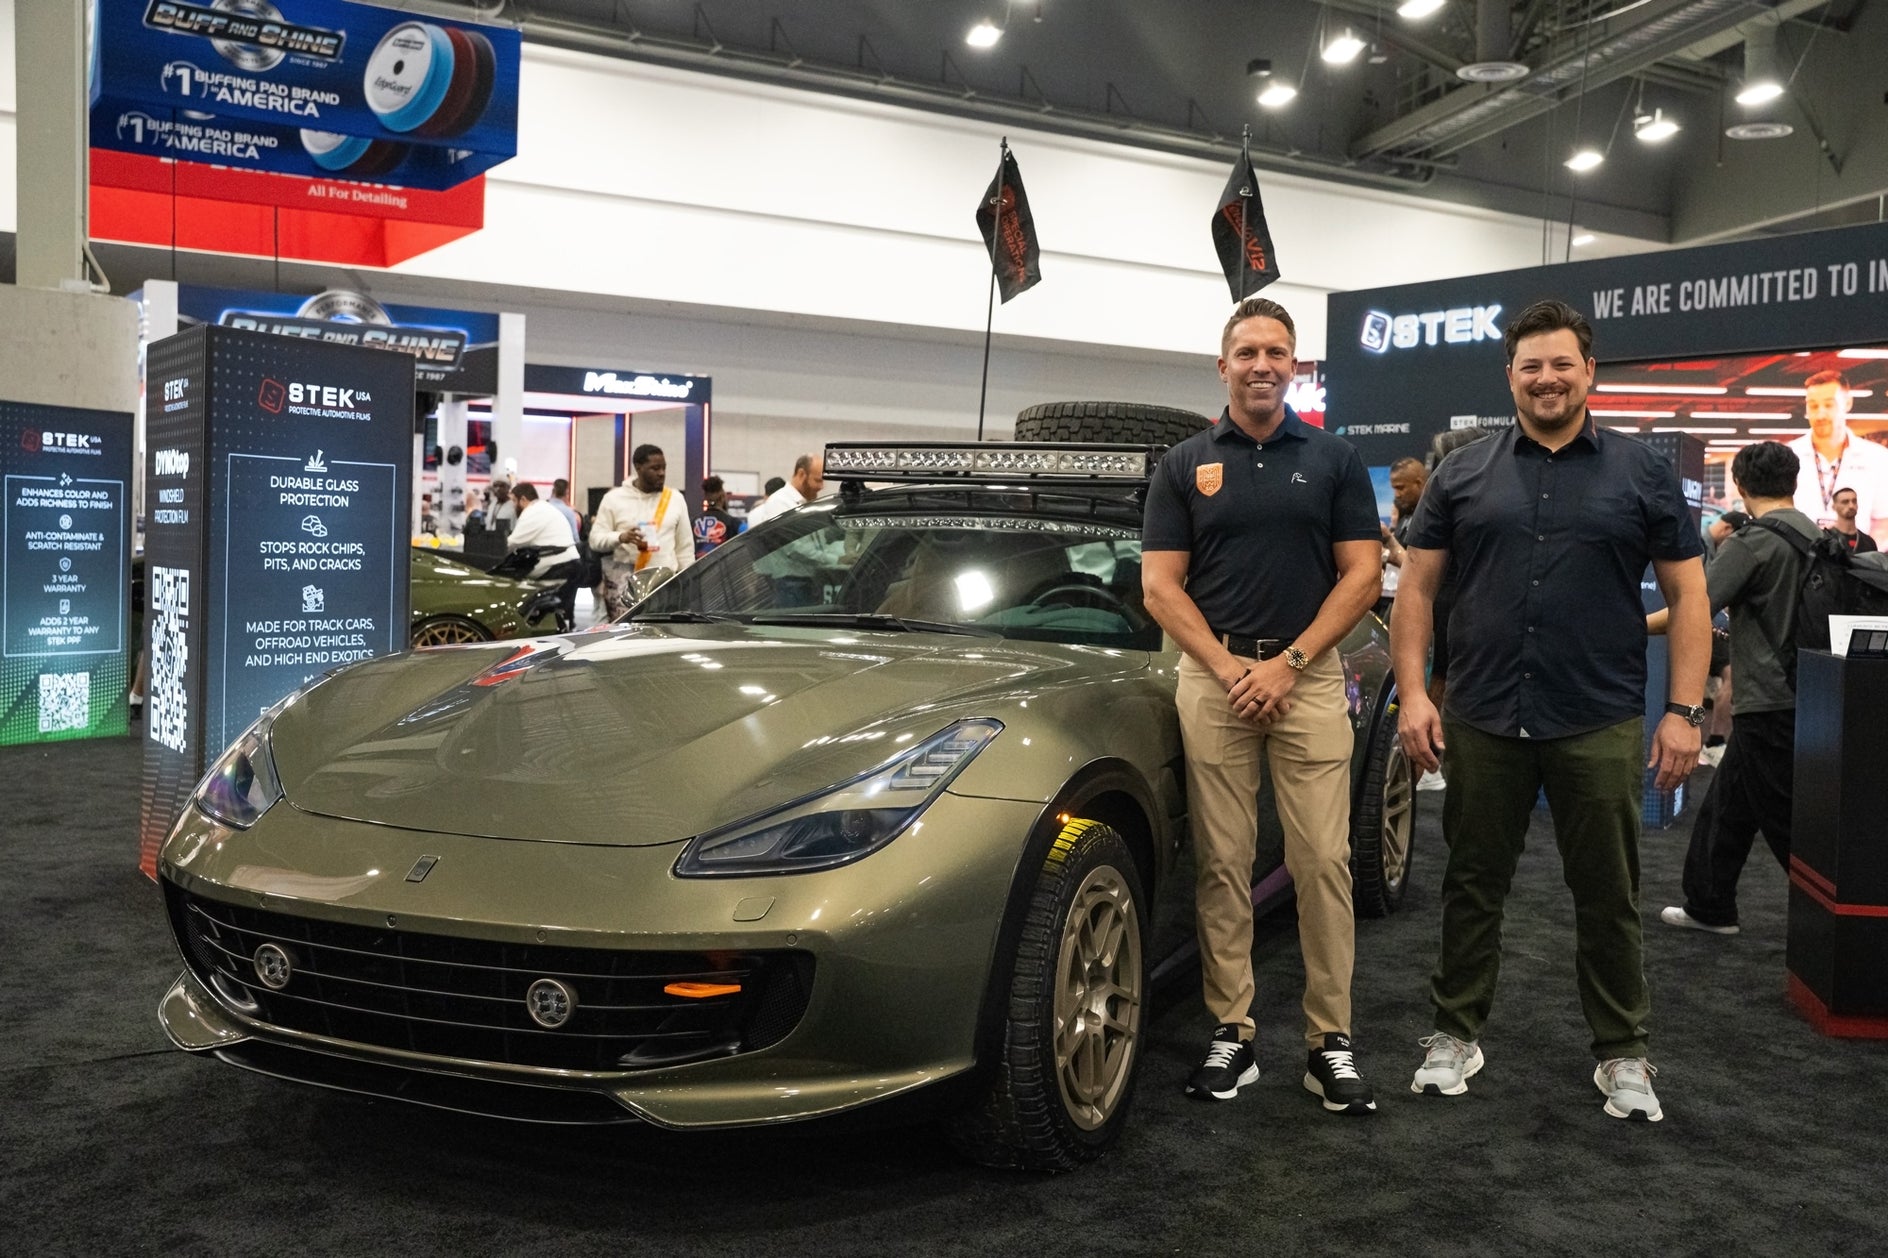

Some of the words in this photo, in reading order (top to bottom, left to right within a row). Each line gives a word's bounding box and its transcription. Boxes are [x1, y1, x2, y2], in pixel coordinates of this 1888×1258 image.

[153, 4, 228, 33] BUFF
[228, 22, 258, 38] AND
[258, 24, 339, 56] SHINE
[163, 63, 191, 96] #1
[194, 69, 256, 92] BUFFING
[260, 81, 289, 97] PAD
[292, 86, 341, 106] BRAND
[215, 89, 320, 119] AMERICA
[147, 119, 202, 138] BUFFING
[205, 128, 232, 142] PAD
[234, 132, 278, 148] BRAND
[166, 134, 260, 160] AMERICA
[308, 184, 326, 197] All
[328, 186, 350, 200] For
[352, 189, 408, 209] Detailing
[1593, 288, 1625, 320] WE
[1631, 283, 1671, 316] ARE
[1679, 267, 1818, 312] COMMITTED
[1828, 262, 1858, 297] TO
[1393, 304, 1502, 349] STEK
[363, 330, 460, 361] SHINE
[289, 382, 355, 409] STEK
[355, 390, 372, 402] USA
[288, 405, 321, 418] PROTECTIVE
[322, 408, 356, 420] AUTOMOTIVE
[356, 412, 371, 422] FILMS
[1347, 424, 1373, 436] STEK
[1374, 422, 1411, 435] MARINE
[42, 431, 90, 448] STEK
[270, 475, 323, 491] DURABLE
[325, 478, 360, 493] GLASS
[22, 487, 64, 499] ENHANCES
[64, 489, 91, 500] COLOR
[91, 490, 108, 501] AND
[280, 492, 349, 508] PROTECTION
[16, 498, 39, 508] ADDS
[40, 498, 77, 509] RICHNESS
[78, 500, 89, 509] TO
[90, 500, 113, 510] FINISH
[695, 516, 717, 537] VP
[25, 531, 97, 542] ANTI-CONTAMINATE
[98, 533, 105, 541] &
[27, 541, 62, 551] SCRATCH
[63, 542, 102, 551] RESISTANT
[260, 541, 296, 555] STOPS
[298, 542, 329, 555] ROCK
[331, 543, 366, 556] CHIPS,
[264, 558, 291, 572] PITS,
[292, 558, 318, 571] AND
[319, 558, 362, 571] CRACKS
[52, 575, 58, 584] 3
[58, 574, 79, 583] YEAR
[43, 584, 87, 593] WARRANTY
[40, 617, 62, 627] ADDS
[63, 616, 69, 626] 2
[69, 616, 89, 626] YEAR
[246, 620, 281, 634] MADE
[283, 619, 306, 633] FOR
[308, 618, 344, 632] TRACK
[345, 617, 376, 631] CARS,
[28, 626, 72, 637] WARRANTY
[73, 626, 83, 636] TO
[84, 626, 100, 636] ANY
[47, 636, 66, 647] STEK
[67, 636, 82, 646] PPF
[255, 636, 312, 650] OFFROAD
[313, 633, 367, 648] VEHICLES,
[245, 655, 272, 668] AND
[274, 653, 303, 666] HIGH
[305, 651, 329, 664] END
[332, 649, 374, 664] EXOTICS
